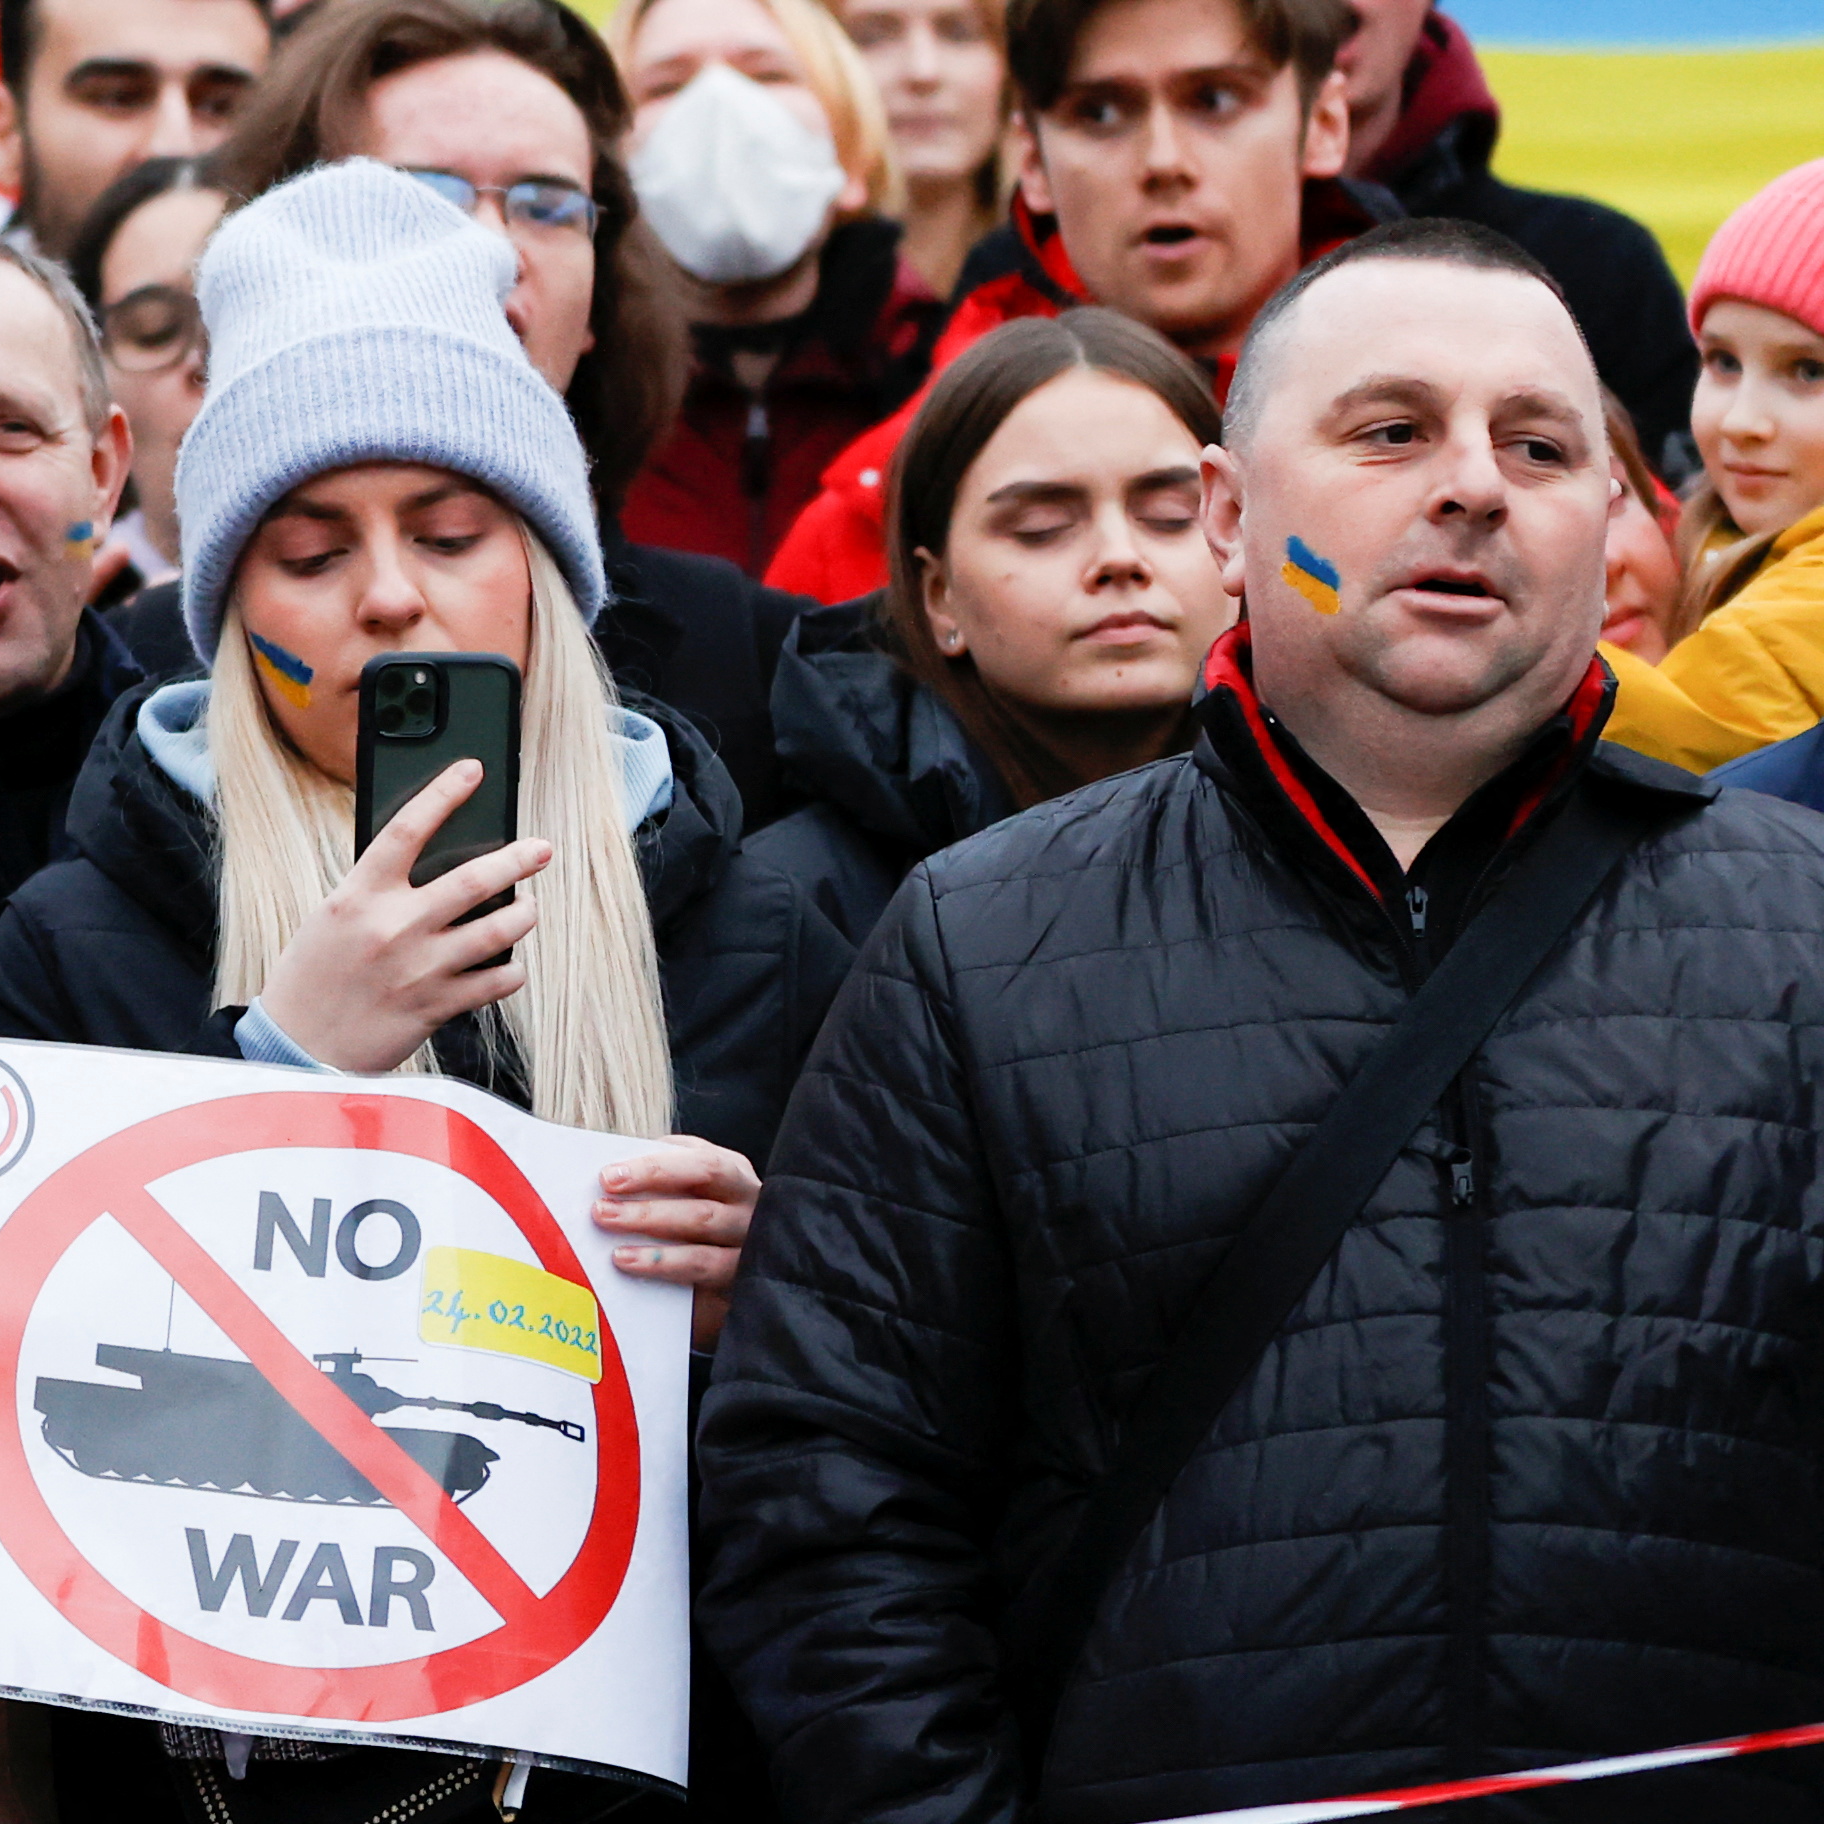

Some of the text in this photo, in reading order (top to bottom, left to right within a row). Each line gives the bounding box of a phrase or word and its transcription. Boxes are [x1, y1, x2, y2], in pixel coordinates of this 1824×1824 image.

[252, 1191, 421, 1282] NO
[421, 1289, 598, 1356] 24.02.2022
[184, 1528, 437, 1632] WAR
